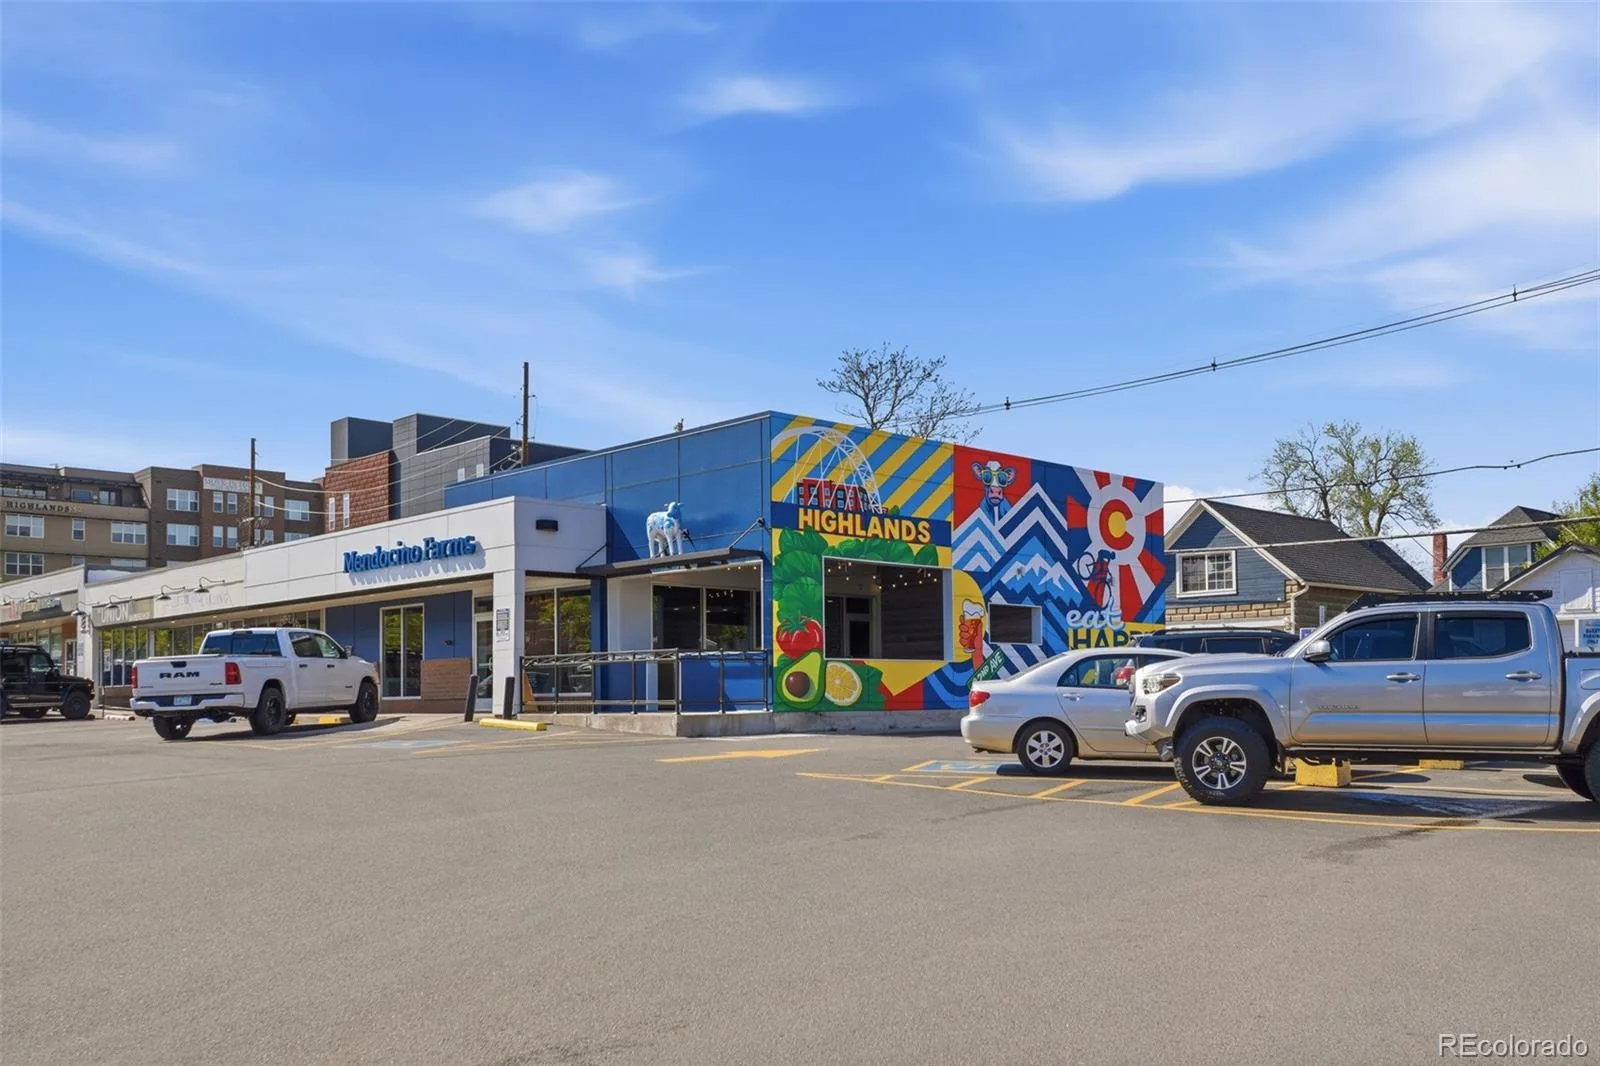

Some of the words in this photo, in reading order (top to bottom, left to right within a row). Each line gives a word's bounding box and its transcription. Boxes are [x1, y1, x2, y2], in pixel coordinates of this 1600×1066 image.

[6, 500, 71, 513] HIGHLANDS
[799, 508, 932, 544] HIGHLANDS
[343, 541, 422, 573] Mendocino
[422, 535, 475, 561] Farms
[1066, 595, 1124, 630] eat
[160, 671, 200, 679] RAM
